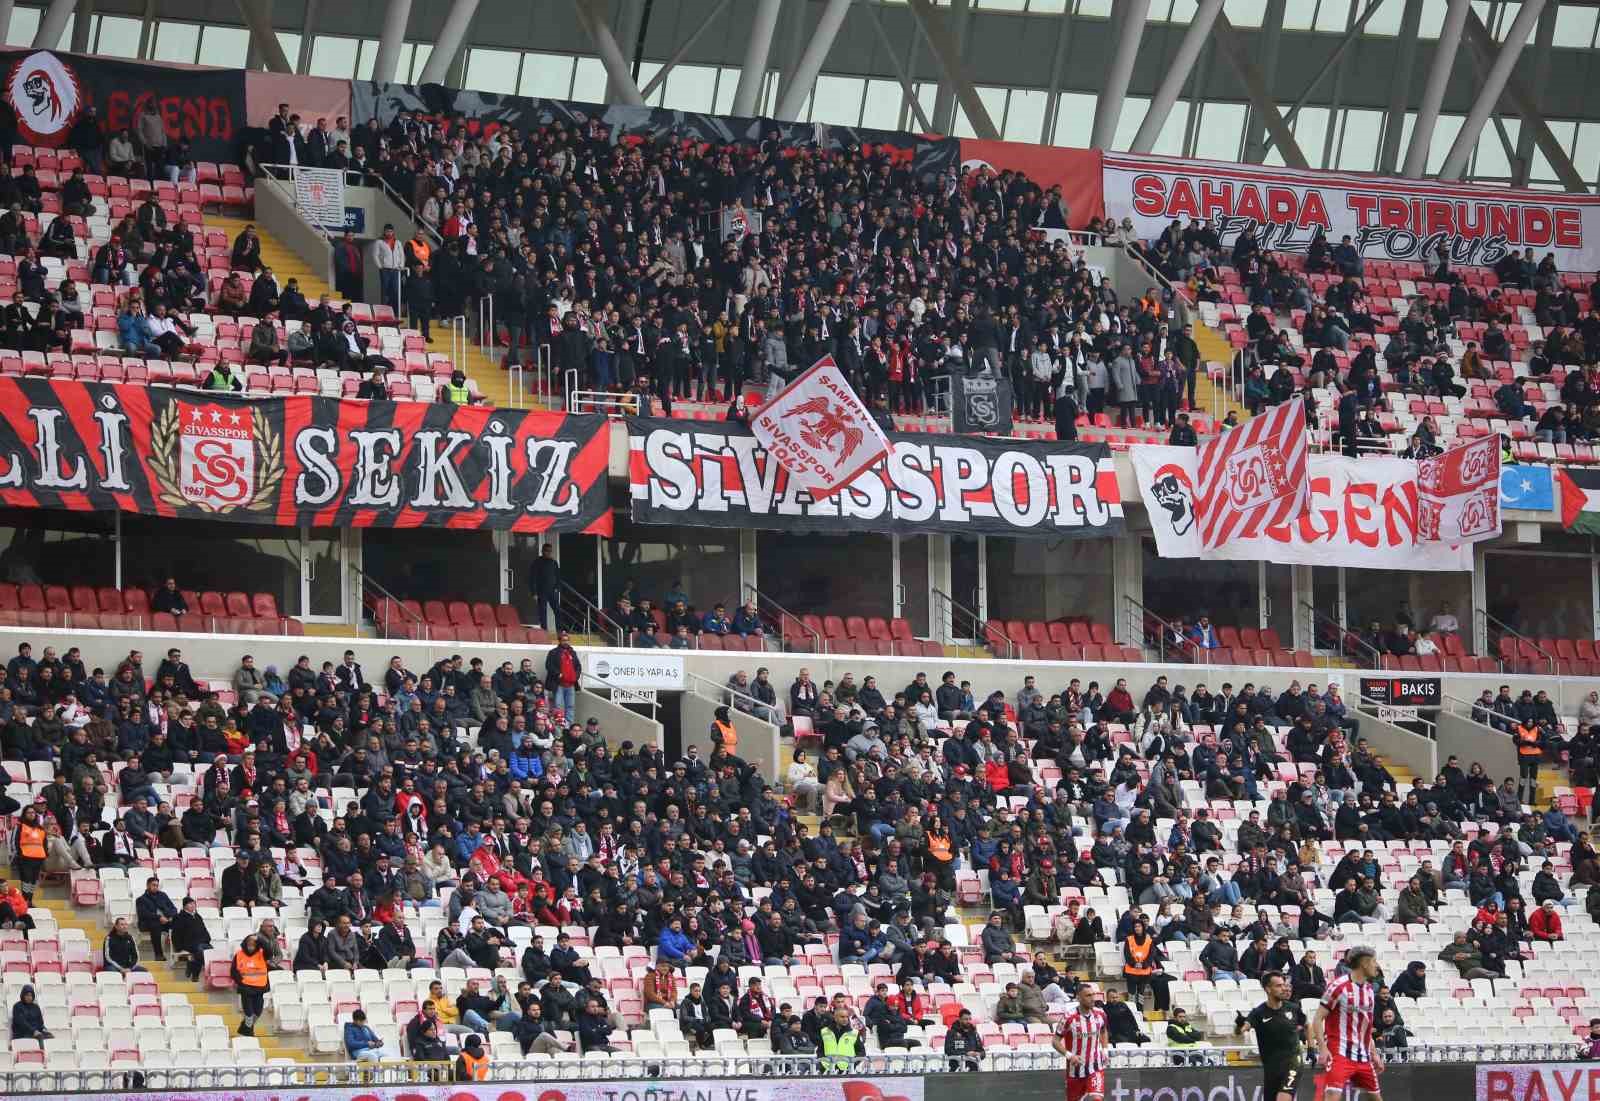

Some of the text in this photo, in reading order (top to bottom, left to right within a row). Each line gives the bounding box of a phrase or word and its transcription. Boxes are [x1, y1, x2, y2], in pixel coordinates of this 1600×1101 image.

[1133, 174, 1582, 249] SAHADA TRIBUNDE
[183, 422, 249, 439] SİVASSPOR
[294, 419, 579, 516] SEKİZ
[184, 486, 205, 497] 1967
